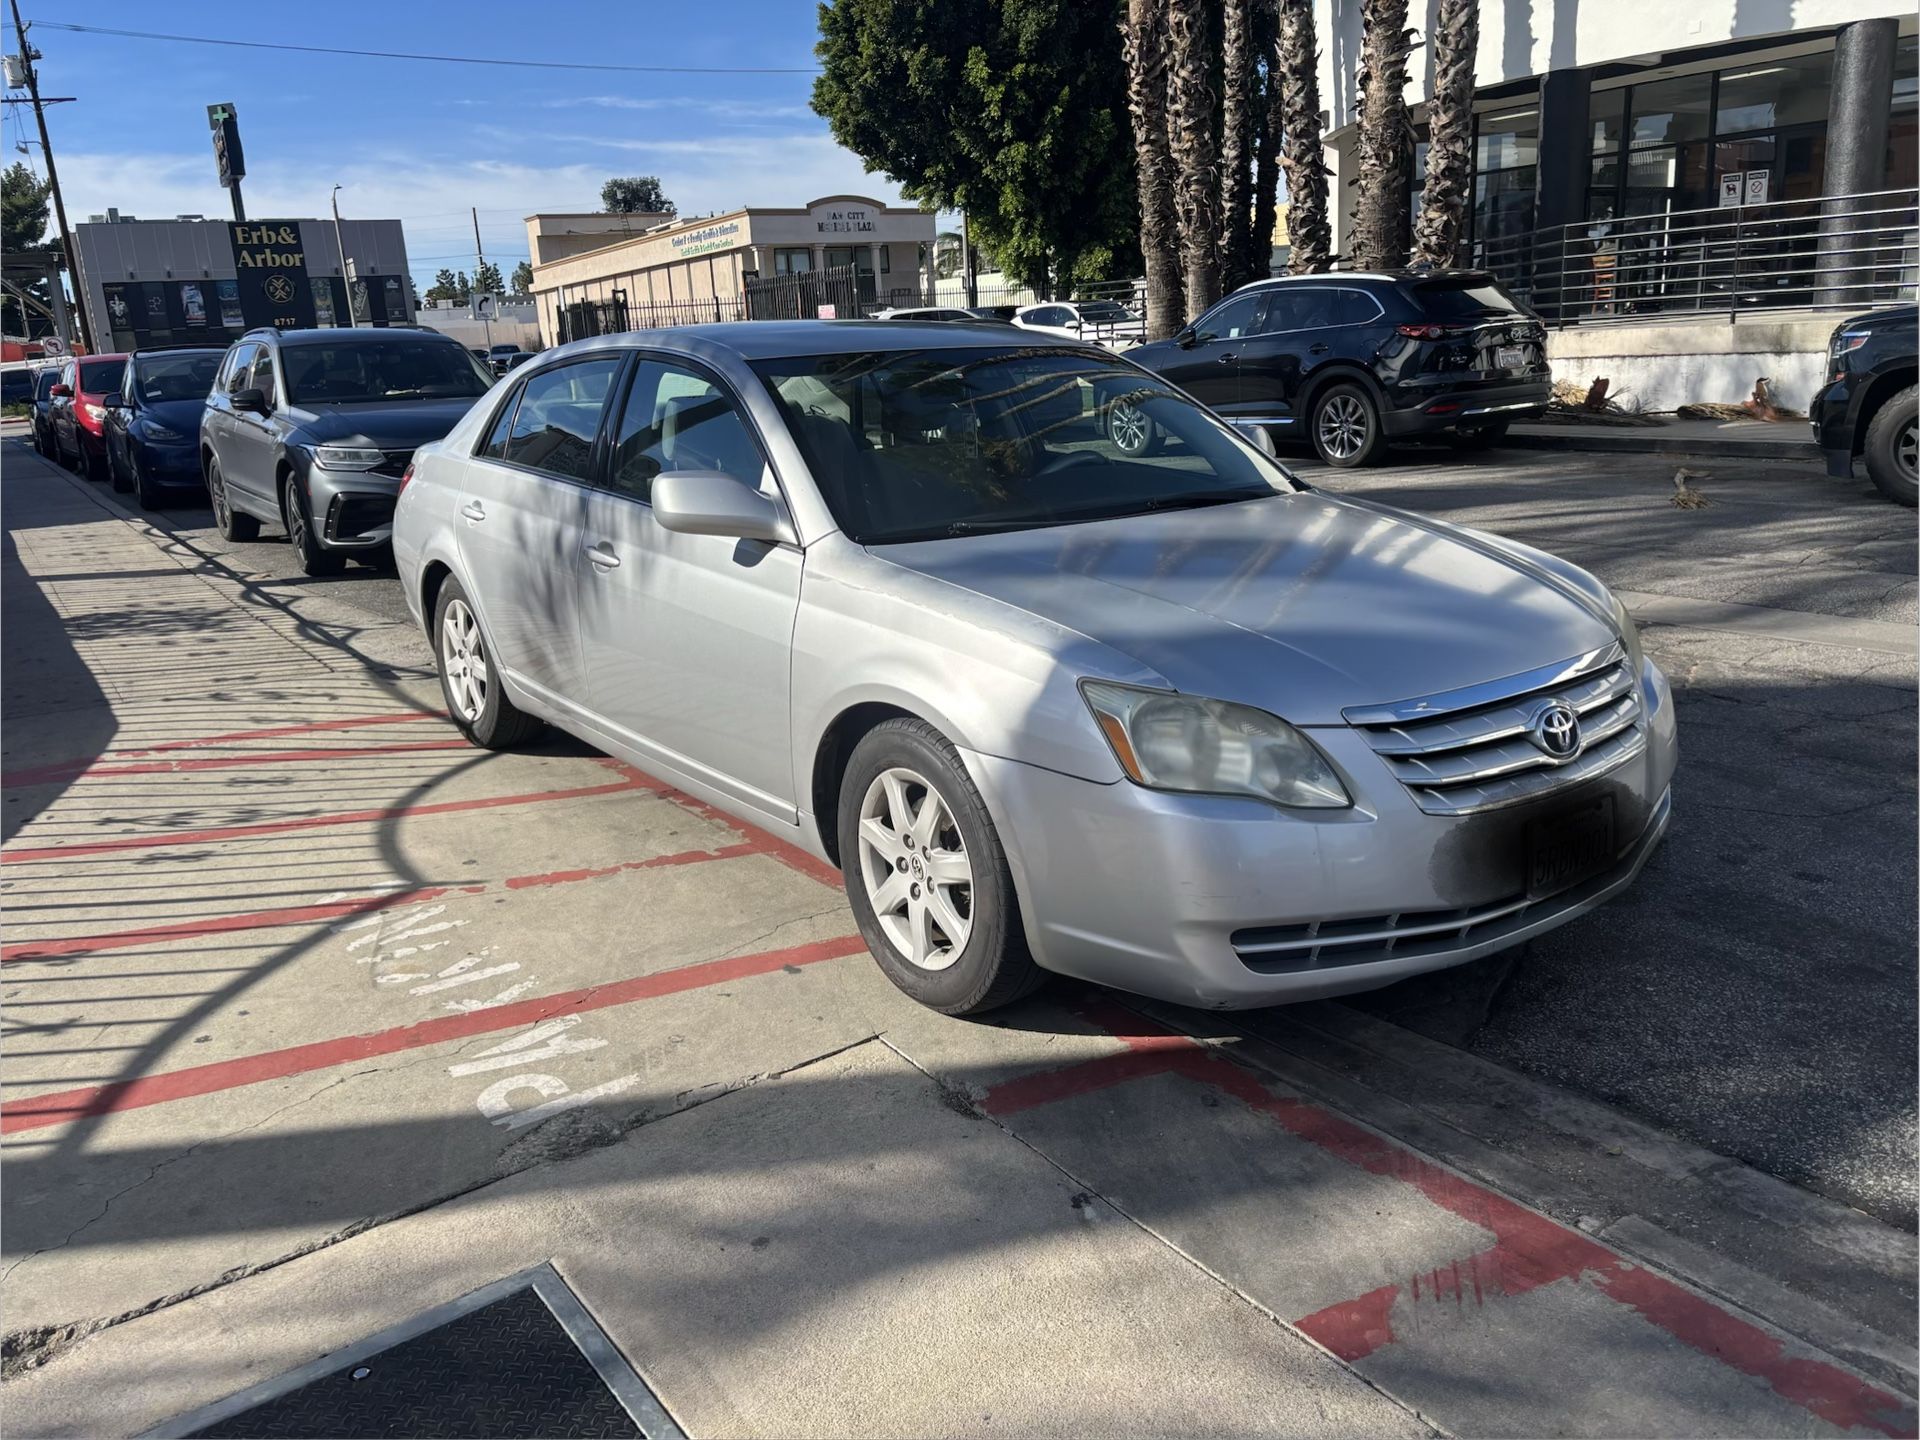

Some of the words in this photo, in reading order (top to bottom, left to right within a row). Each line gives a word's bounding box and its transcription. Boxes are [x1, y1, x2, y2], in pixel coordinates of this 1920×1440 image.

[847, 211, 865, 220] CITY
[237, 248, 303, 268] Arbor
[477, 311, 494, 319] ONLY
[274, 317, 296, 326] 8717
